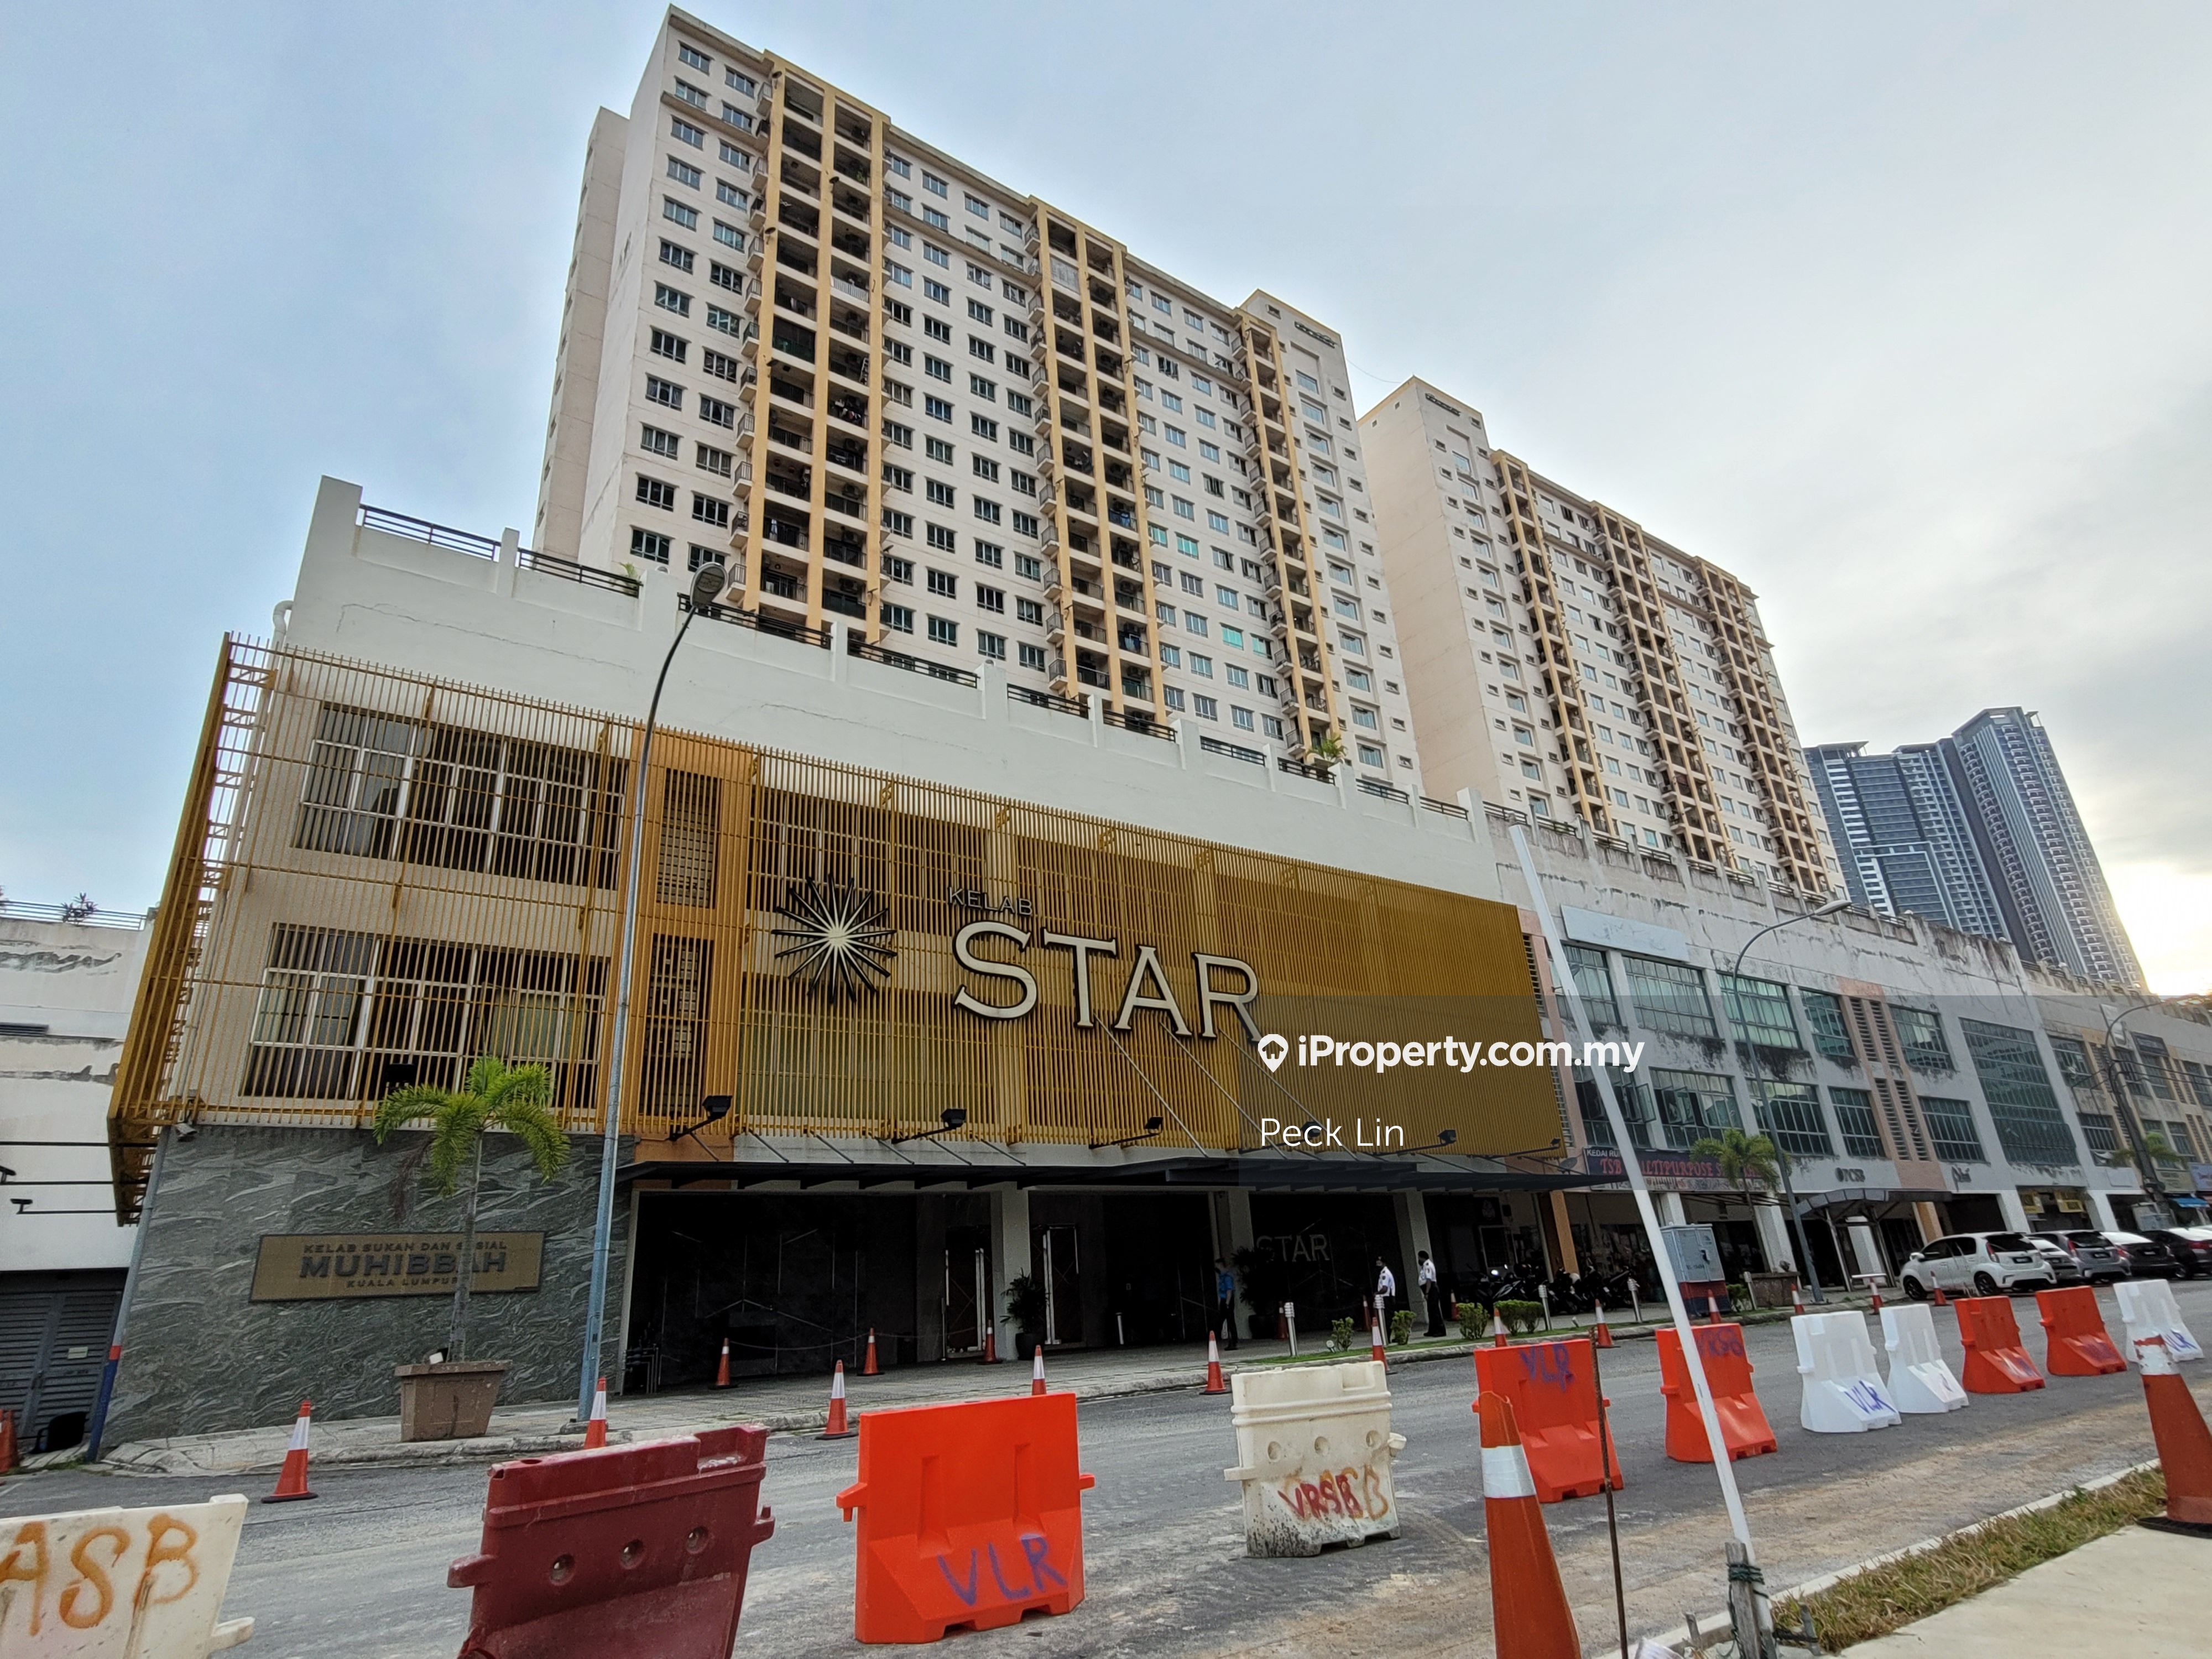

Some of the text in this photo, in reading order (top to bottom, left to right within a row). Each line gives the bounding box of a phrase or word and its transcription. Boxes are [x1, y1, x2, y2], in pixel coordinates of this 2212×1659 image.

[947, 886, 1034, 916] KELAB
[952, 919, 1265, 1044] STAR
[303, 1240, 507, 1254] KELAB SUKAN DAN SSIAL
[346, 1279, 395, 1288] KUALA
[1519, 1343, 1575, 1393] VLR
[0, 1513, 200, 1636] ASB
[937, 1533, 1067, 1606] VLR
